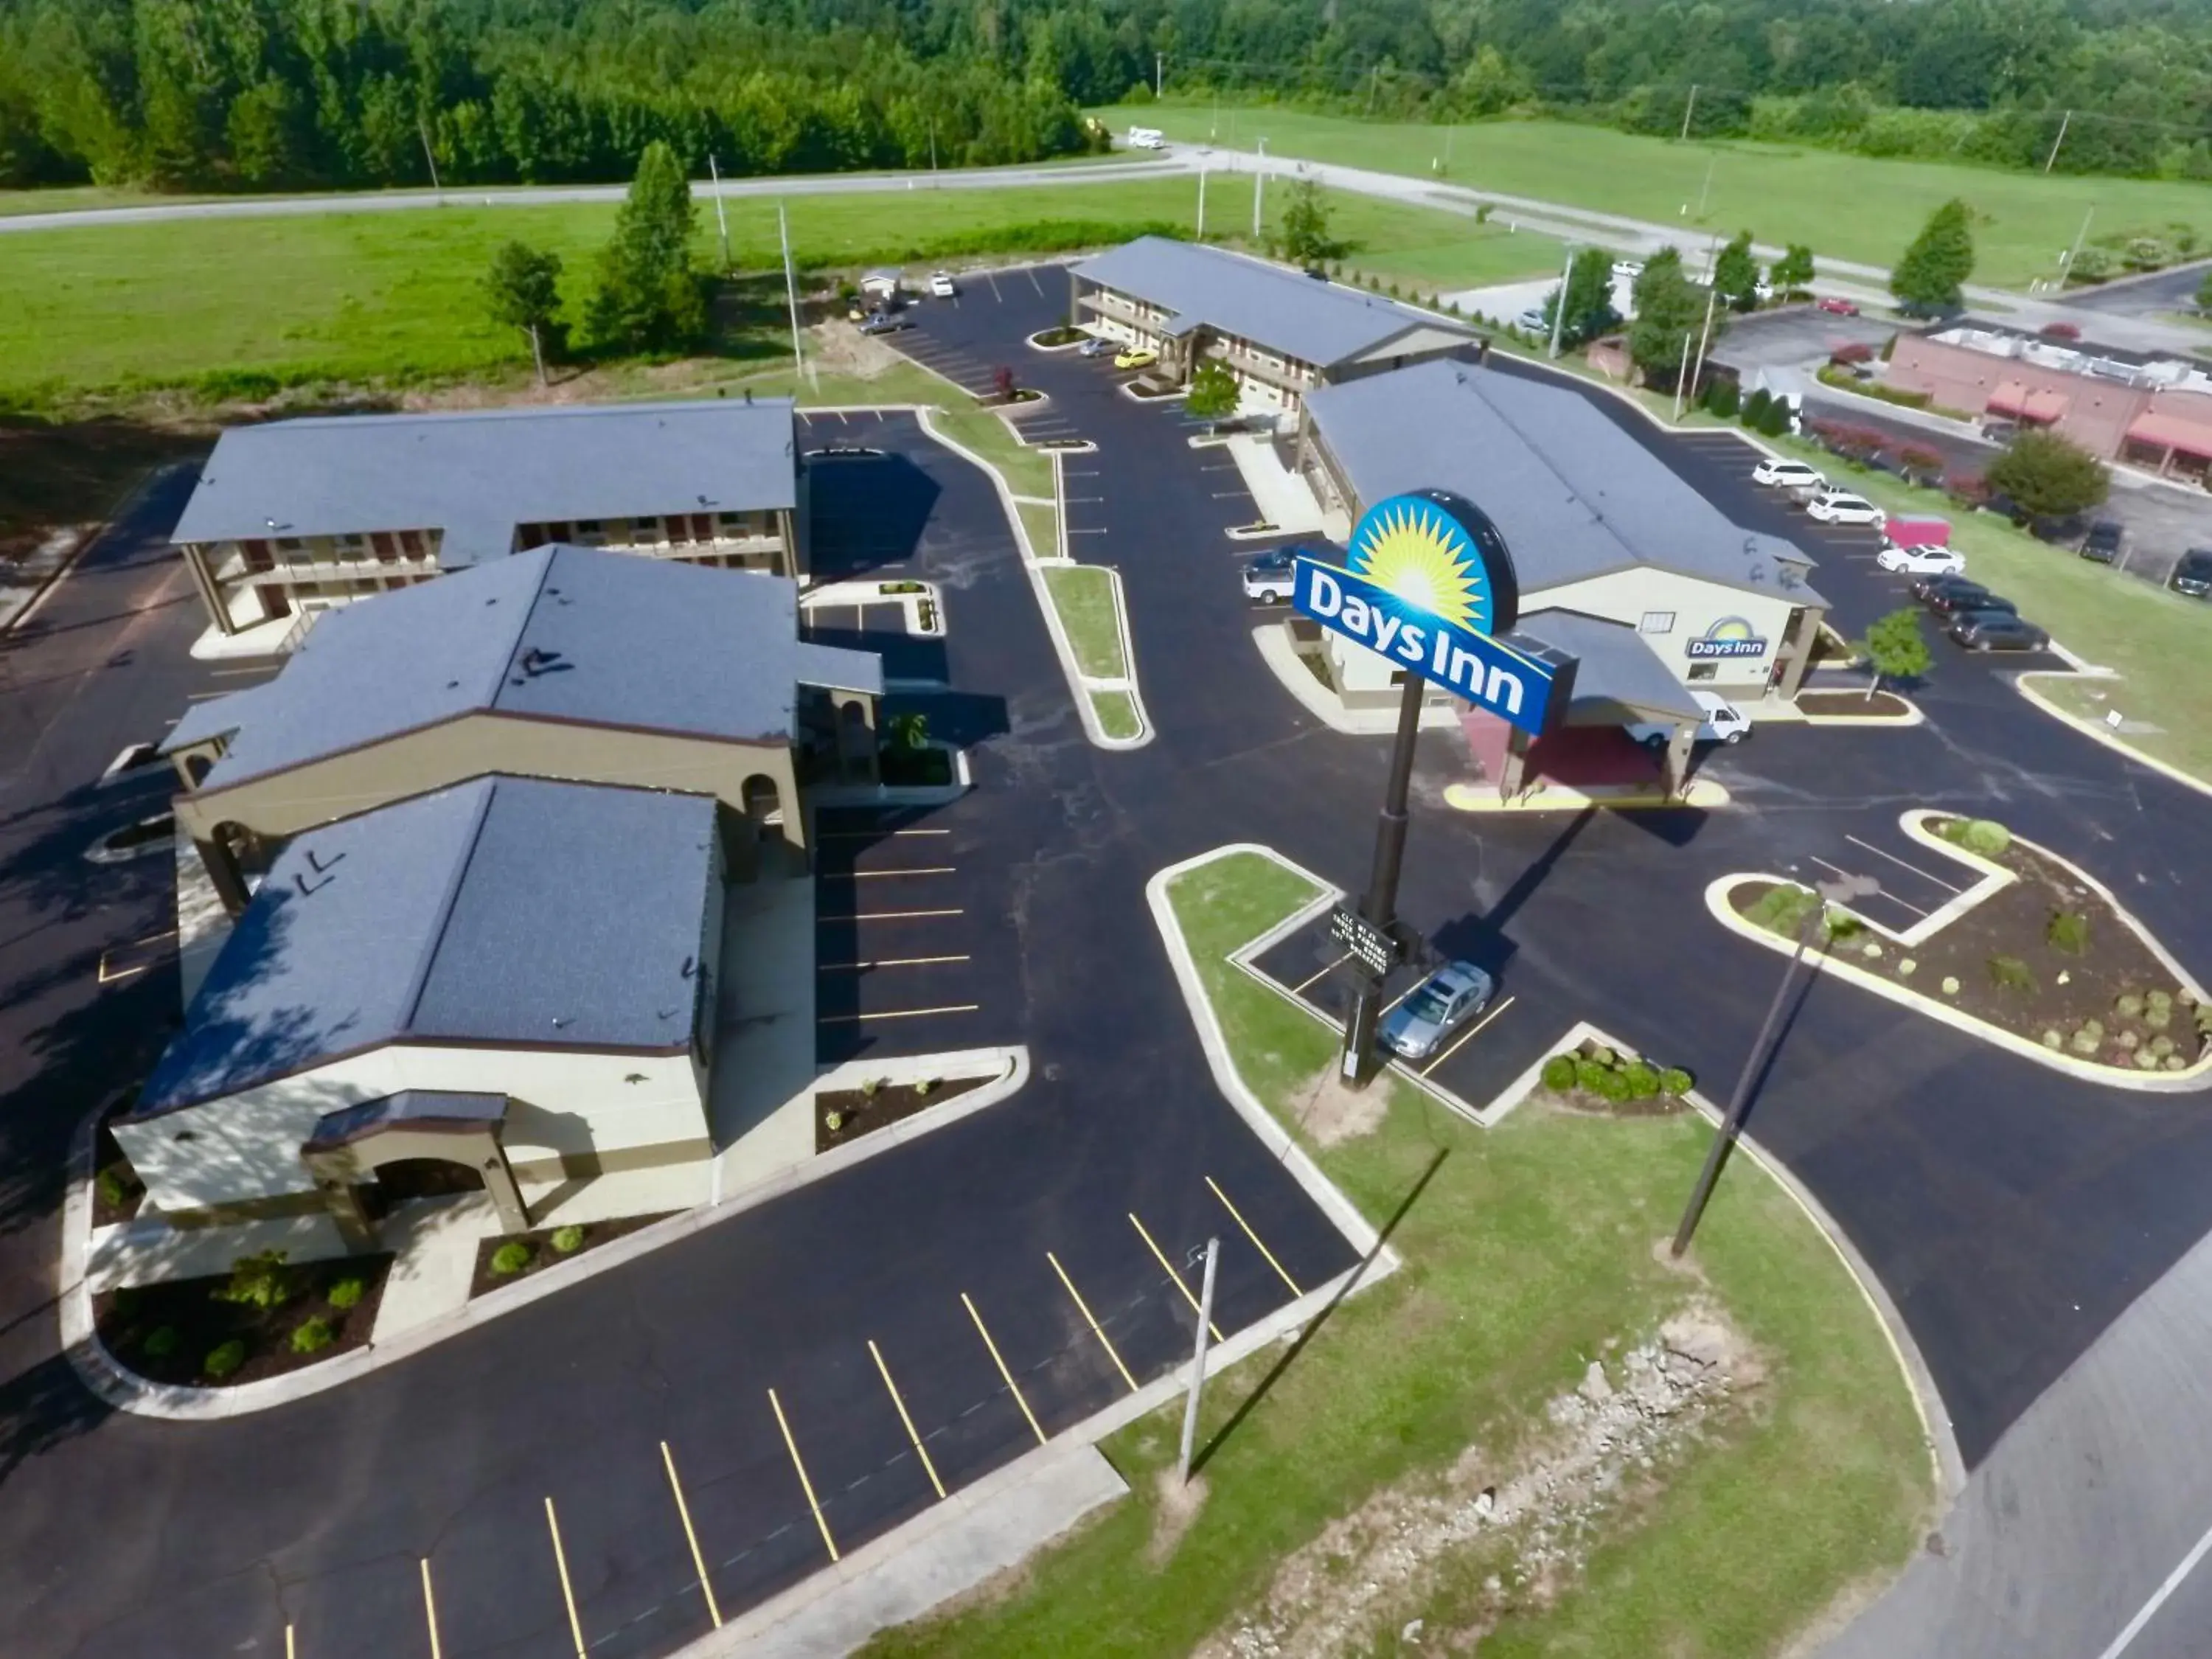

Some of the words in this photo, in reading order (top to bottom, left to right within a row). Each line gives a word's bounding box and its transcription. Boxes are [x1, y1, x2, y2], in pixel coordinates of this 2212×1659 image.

[1310, 569, 1425, 661] Days
[1432, 629, 1524, 715] Inn
[1691, 641, 1733, 655] Days
[1734, 641, 1763, 654] Inn
